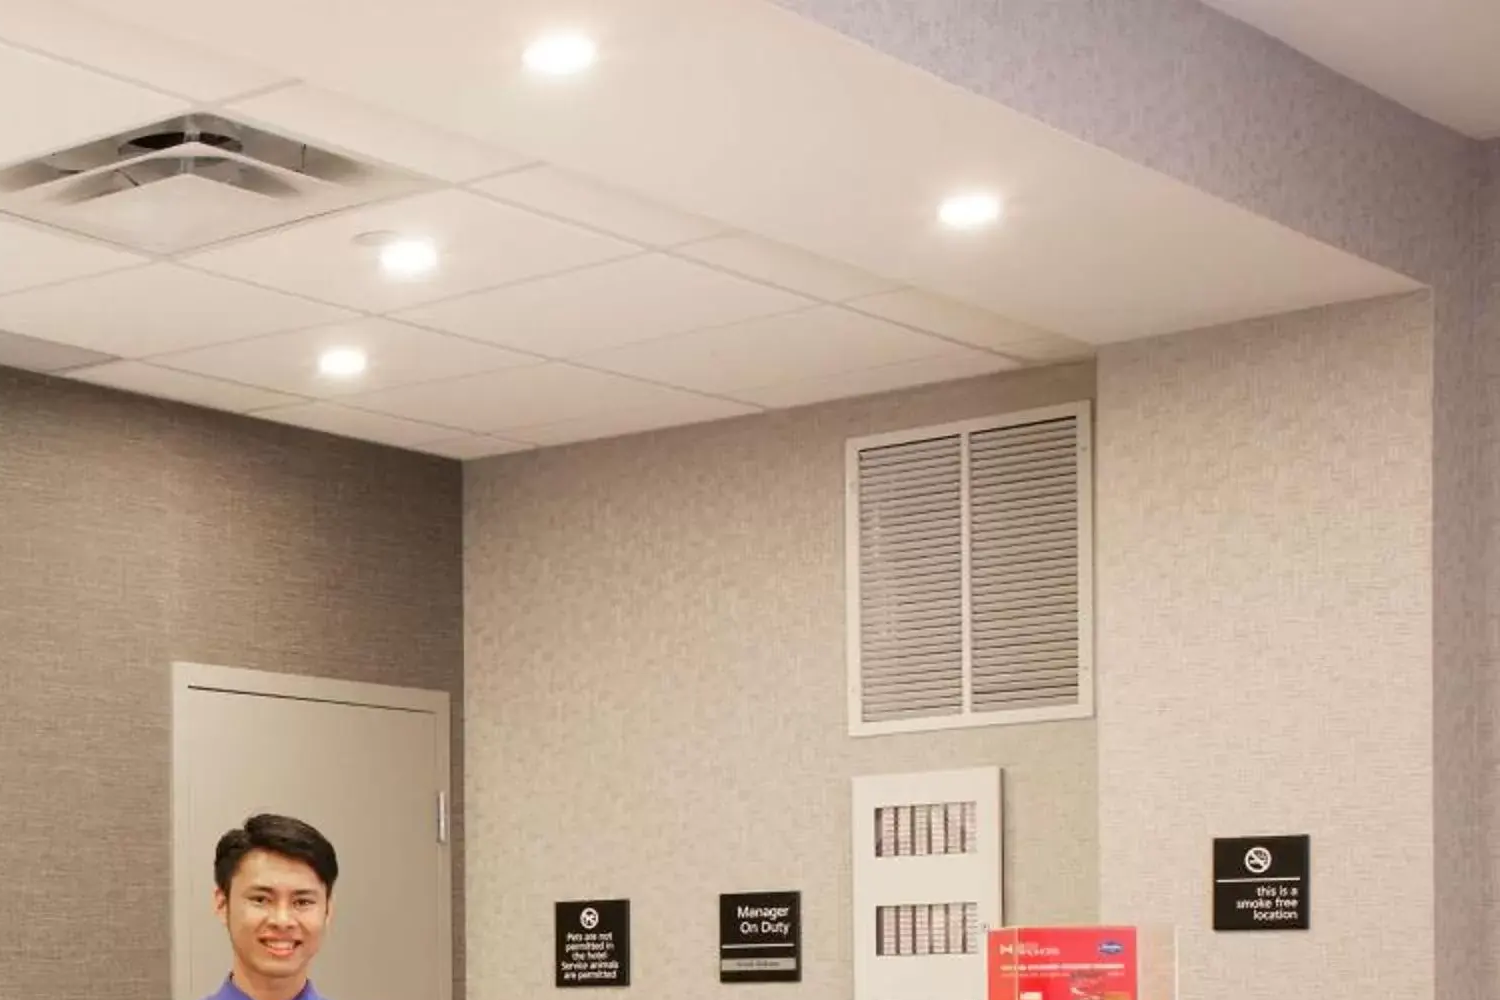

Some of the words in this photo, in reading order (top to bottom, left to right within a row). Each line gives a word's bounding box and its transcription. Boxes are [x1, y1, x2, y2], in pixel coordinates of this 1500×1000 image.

[1257, 885, 1277, 897] this
[1279, 885, 1288, 897] is
[1290, 887, 1299, 896] a
[1236, 898, 1273, 909] smoke
[1275, 897, 1299, 909] free
[737, 905, 789, 921] Manager
[1253, 909, 1299, 921] location
[740, 921, 759, 935] On
[761, 921, 791, 936] Duty
